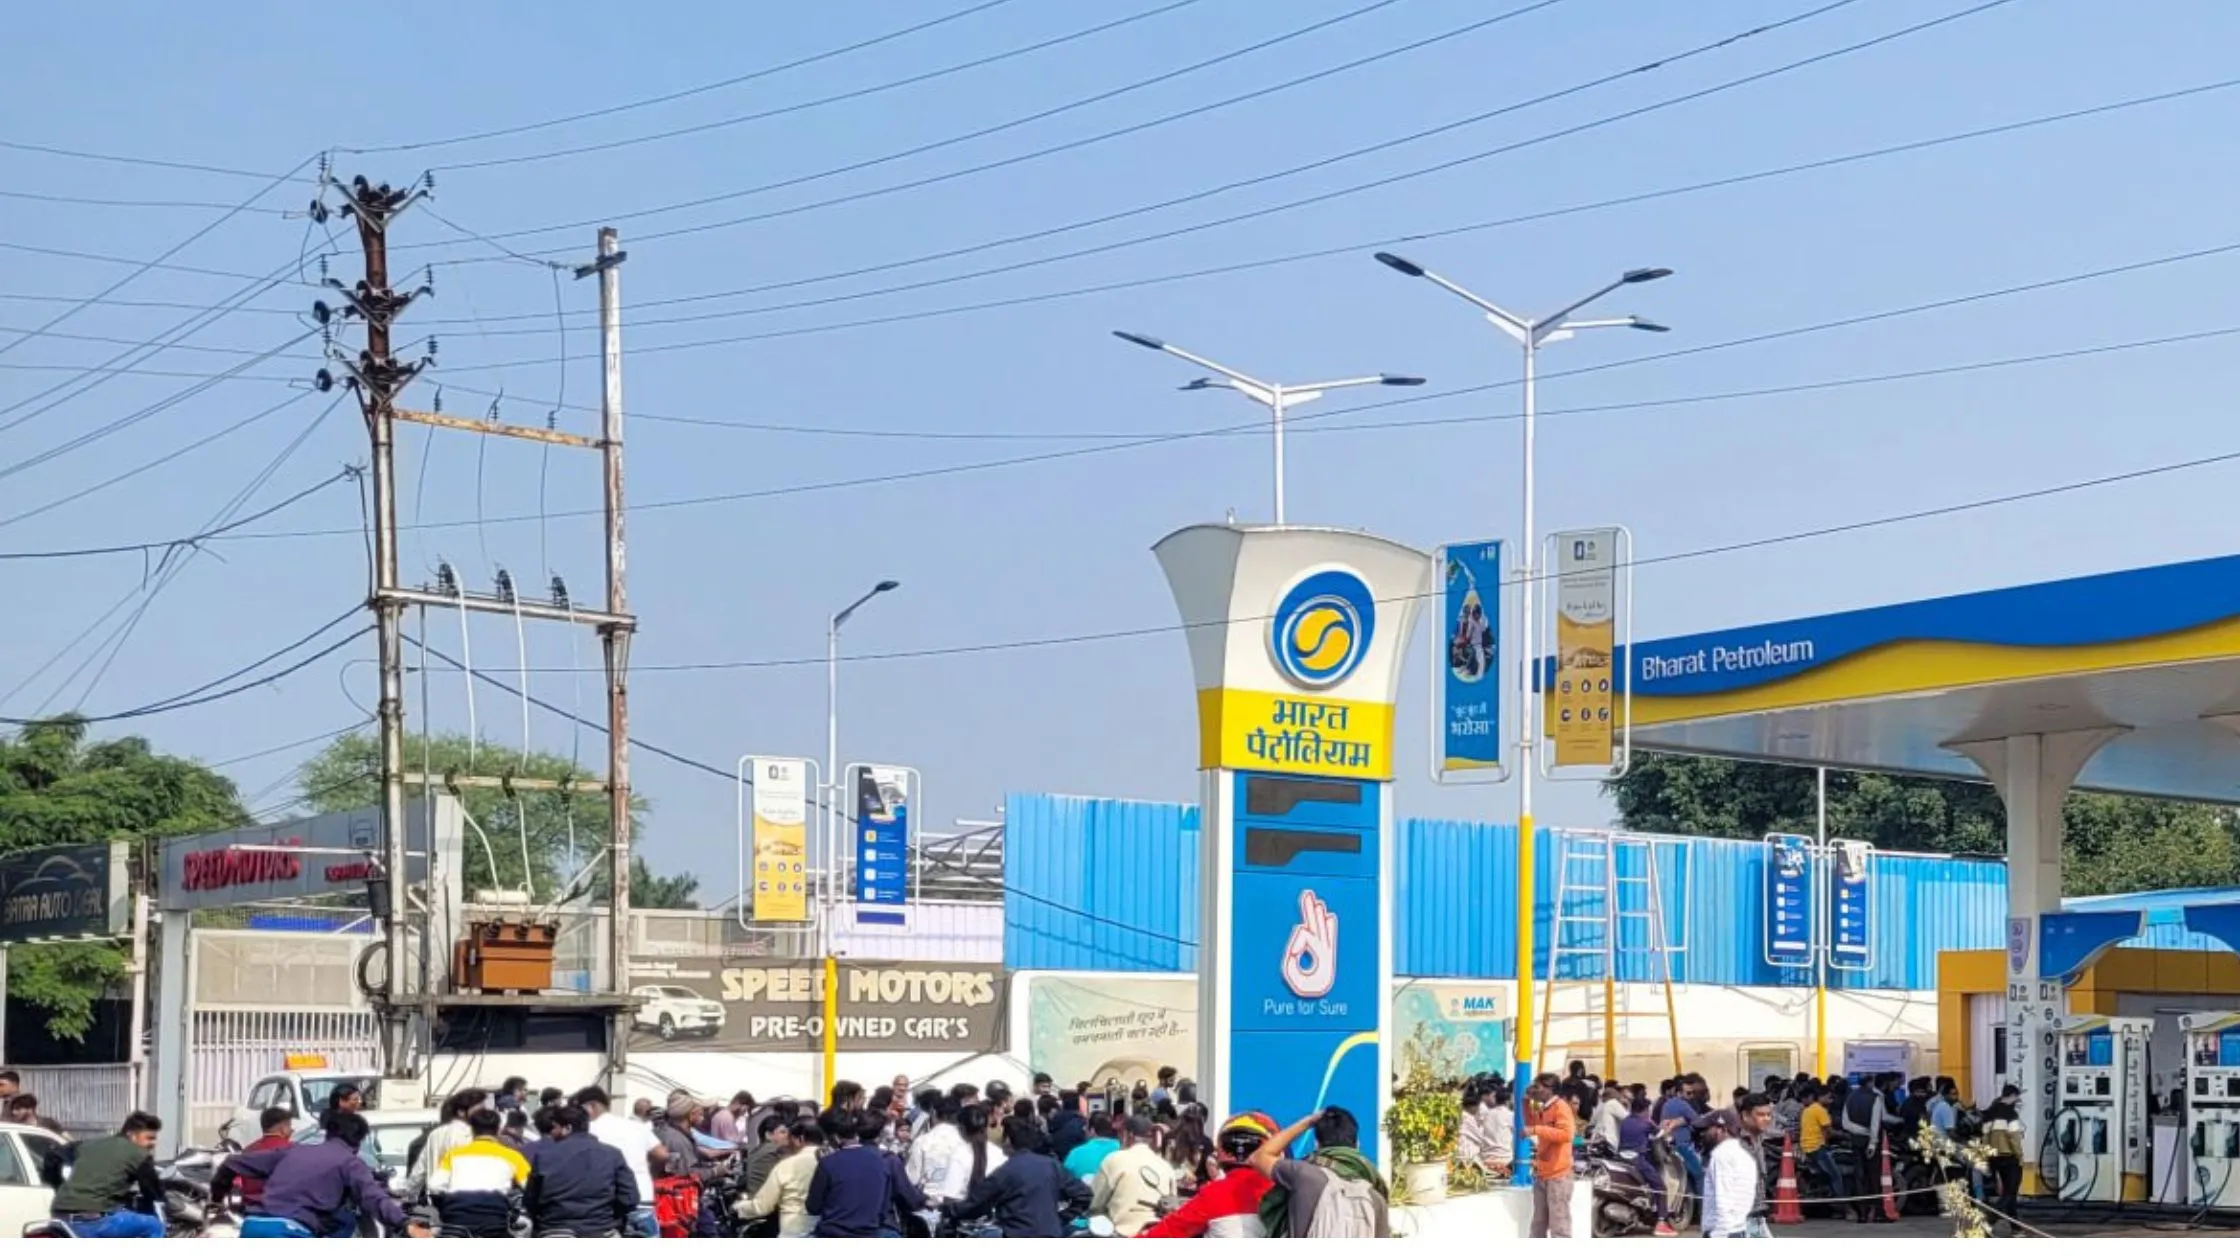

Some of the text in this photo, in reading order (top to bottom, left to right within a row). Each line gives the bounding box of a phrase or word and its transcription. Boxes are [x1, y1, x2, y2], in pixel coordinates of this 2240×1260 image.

[1642, 640, 1814, 681] Bharat Petroleum
[1273, 700, 1350, 730] भारत
[1246, 727, 1371, 767] पेट्रोलियम
[40, 890, 71, 920] AUTO
[849, 969, 994, 1006] MOTORS
[1464, 996, 1496, 1009] MAK
[1264, 998, 1347, 1015] Pure for Sure
[904, 1015, 969, 1041] CAR'S
